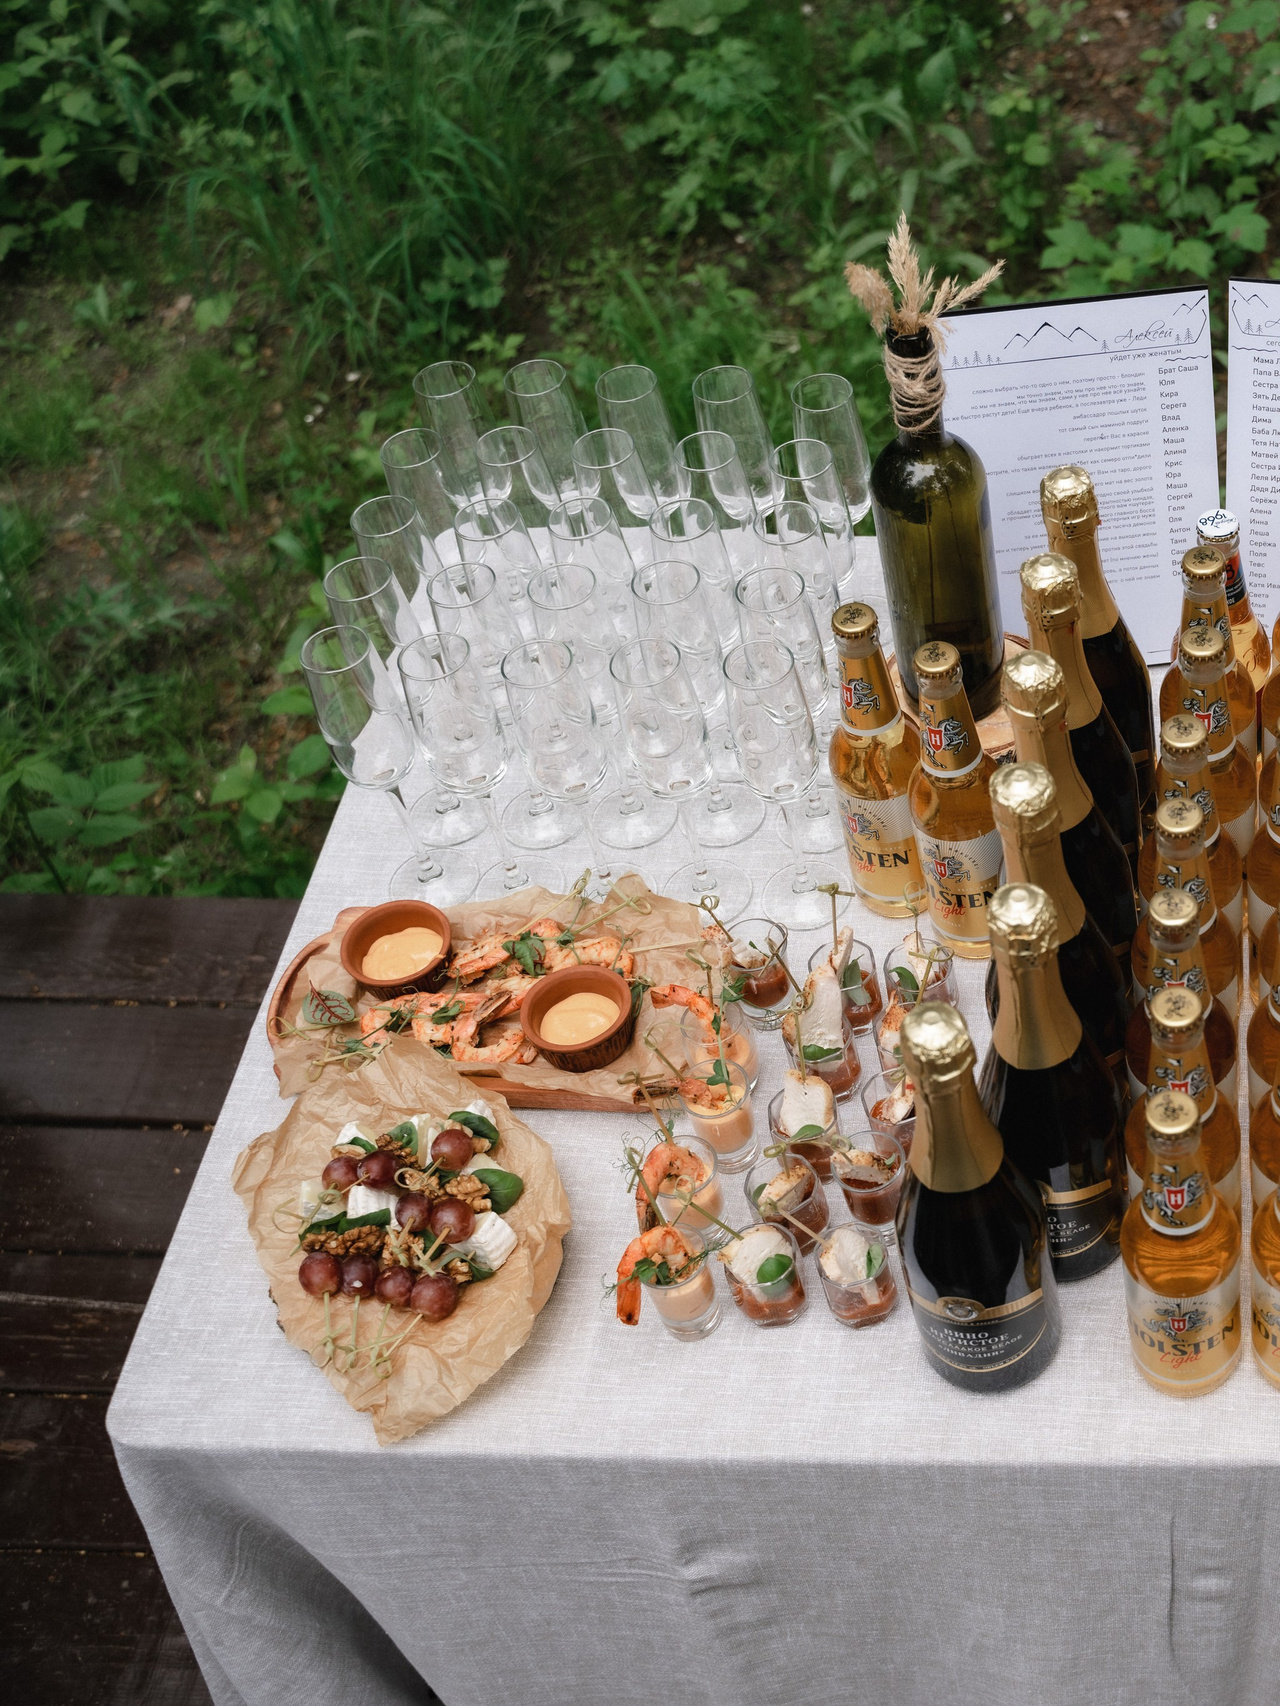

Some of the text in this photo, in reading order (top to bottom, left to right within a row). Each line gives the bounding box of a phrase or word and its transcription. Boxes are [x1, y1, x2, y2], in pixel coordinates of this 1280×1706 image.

[1114, 320, 1173, 348] Алексей
[1109, 347, 1182, 364] уйдет уже женатым
[1252, 354, 1274, 365] Мама
[1157, 361, 1199, 377] Брат Саша
[1252, 366, 1272, 376] Папа
[1157, 376, 1176, 387] Юля
[1252, 378, 1279, 391] Сестра
[1159, 388, 1179, 400] Кира
[1252, 390, 1270, 400] Зять
[1159, 399, 1187, 412] Серега
[1251, 402, 1280, 413] Наташа
[1160, 411, 1181, 424] Влад
[1251, 413, 1272, 426] Дима
[1161, 422, 1189, 434] Аленка
[1251, 425, 1270, 435] Баба
[1162, 434, 1185, 445] Маша
[1252, 436, 1268, 447] Тетя
[1162, 445, 1187, 456] Алина
[1250, 448, 1279, 459] Матвей
[1163, 457, 1183, 470] Крис
[1250, 460, 1277, 472] Сестра
[1164, 468, 1182, 481] Юра
[1165, 479, 1188, 490] Маша
[1249, 482, 1269, 495] Дядя
[1165, 490, 1193, 503] Сергей
[1249, 494, 1278, 506] Серёжа
[1166, 502, 1186, 512] Геля
[1249, 505, 1272, 515] Алена
[1167, 513, 1183, 524] Оля
[1199, 510, 1227, 526] 1968
[1249, 516, 1269, 526] Инна
[1168, 523, 1191, 534] Антон
[1248, 526, 1270, 537] Леша
[1170, 534, 1187, 545] Таня
[1248, 537, 1277, 550] Серёжа
[1170, 547, 1187, 557] Саш
[1248, 547, 1267, 558] Поля
[1248, 568, 1267, 580] Лера
[1248, 579, 1280, 590] Катя Ива
[1247, 589, 1269, 599] Света
[931, 732, 940, 746] H
[852, 845, 909, 868] STEN
[937, 864, 945, 874] H
[934, 898, 966, 919] Light
[1170, 1193, 1182, 1205] H
[1174, 1321, 1184, 1329] H
[930, 1326, 1009, 1346] ИГРИСТОЕ
[944, 1328, 989, 1340] ВИНО
[1160, 1350, 1203, 1369] Light
